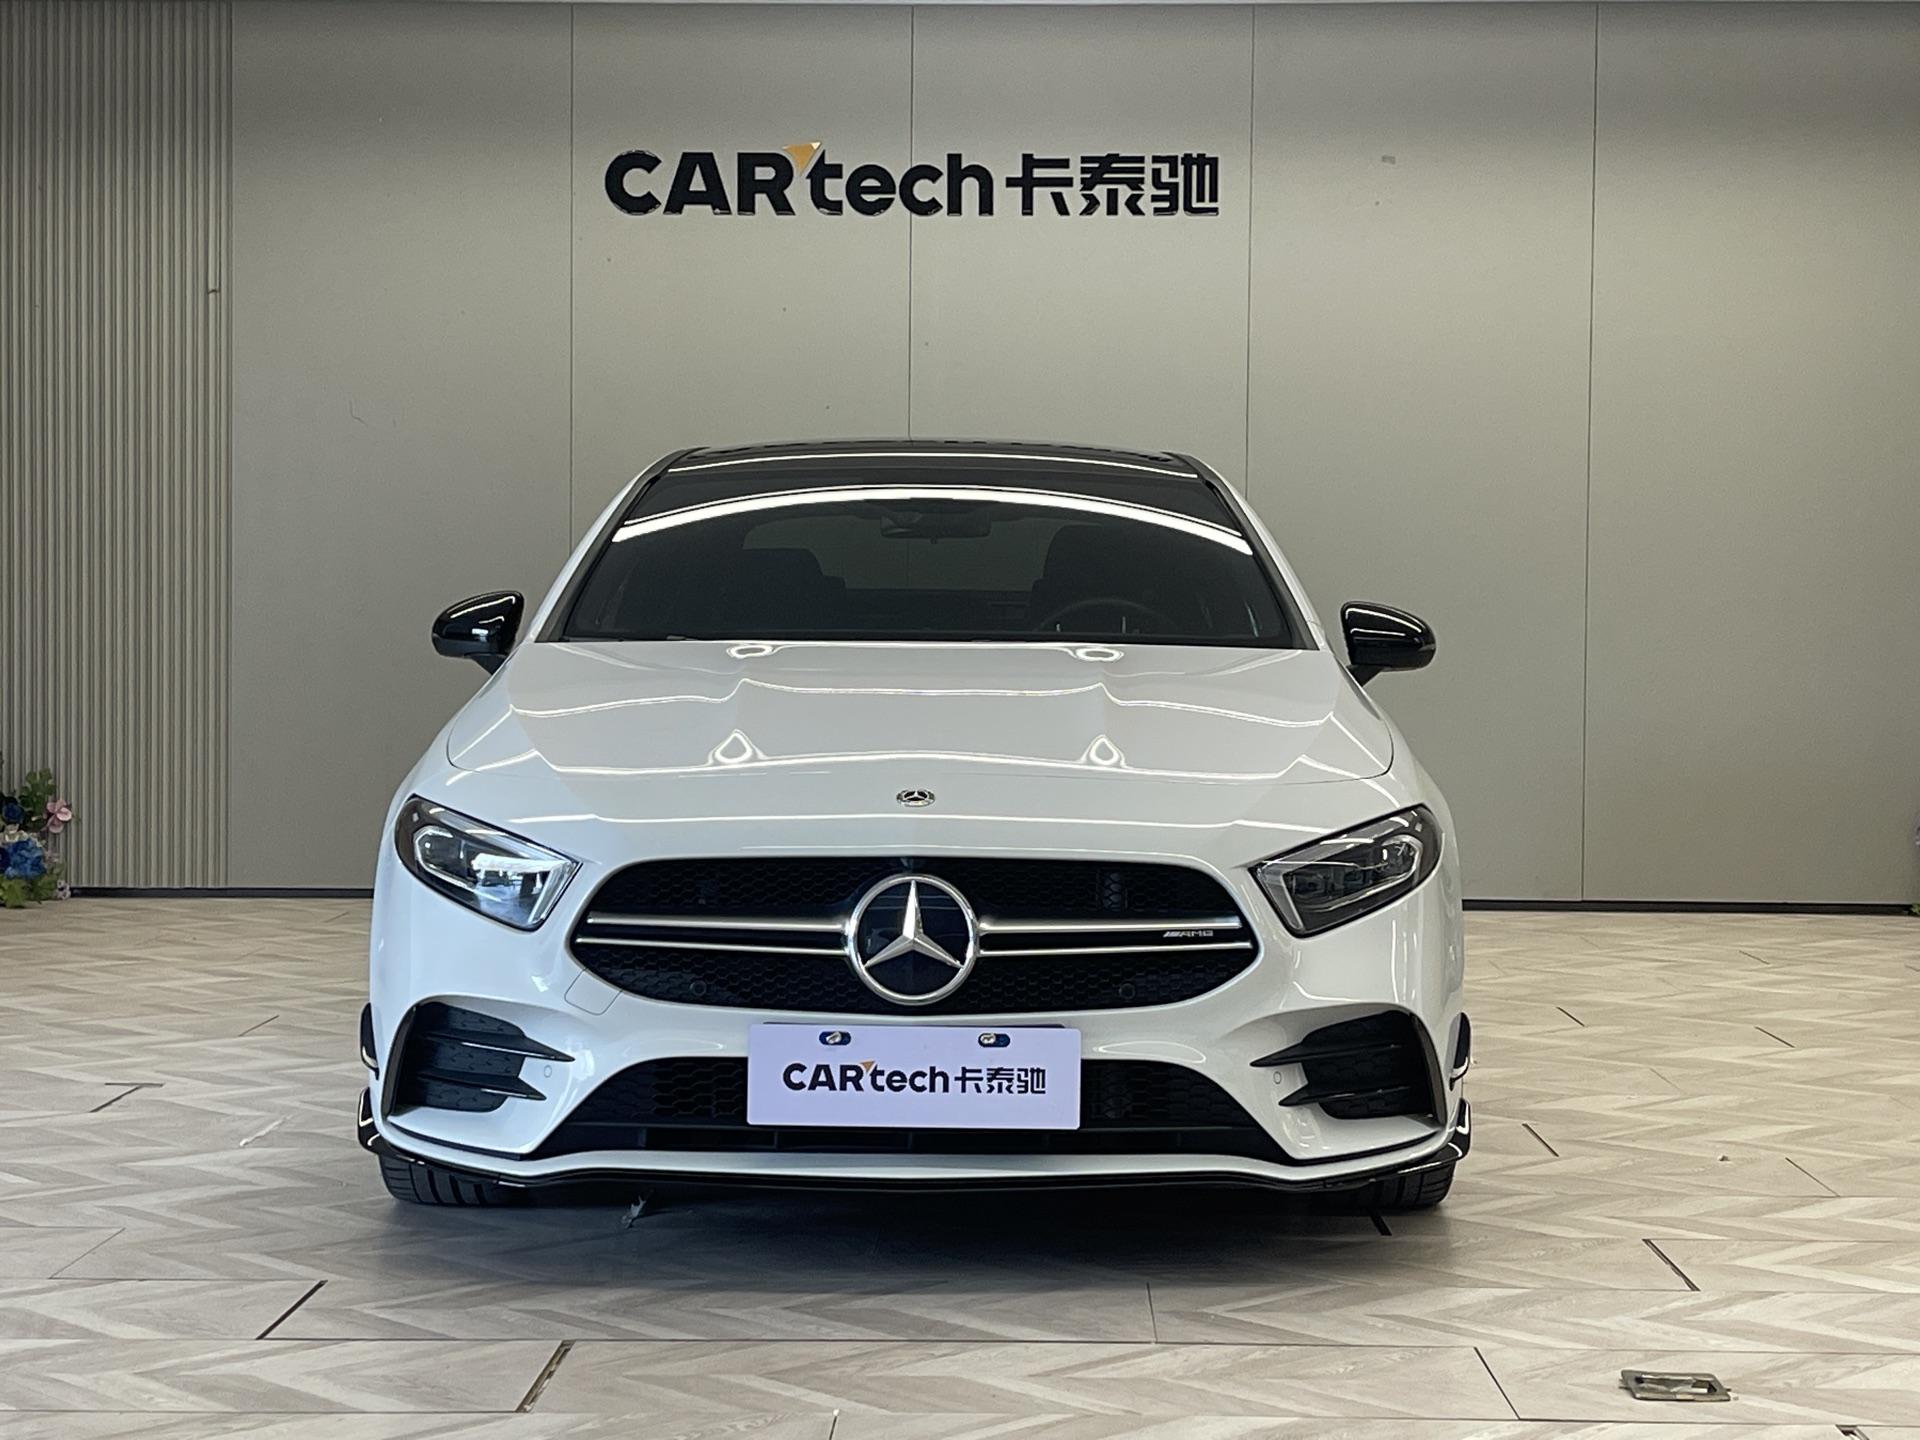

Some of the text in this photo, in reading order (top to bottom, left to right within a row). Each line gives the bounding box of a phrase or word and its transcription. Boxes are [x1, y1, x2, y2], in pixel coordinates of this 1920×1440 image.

[604, 150, 1220, 217] CARtech 卡泰驰
[1177, 930, 1214, 938] AMG
[783, 1062, 1047, 1095] CARtech 卡泰驰
